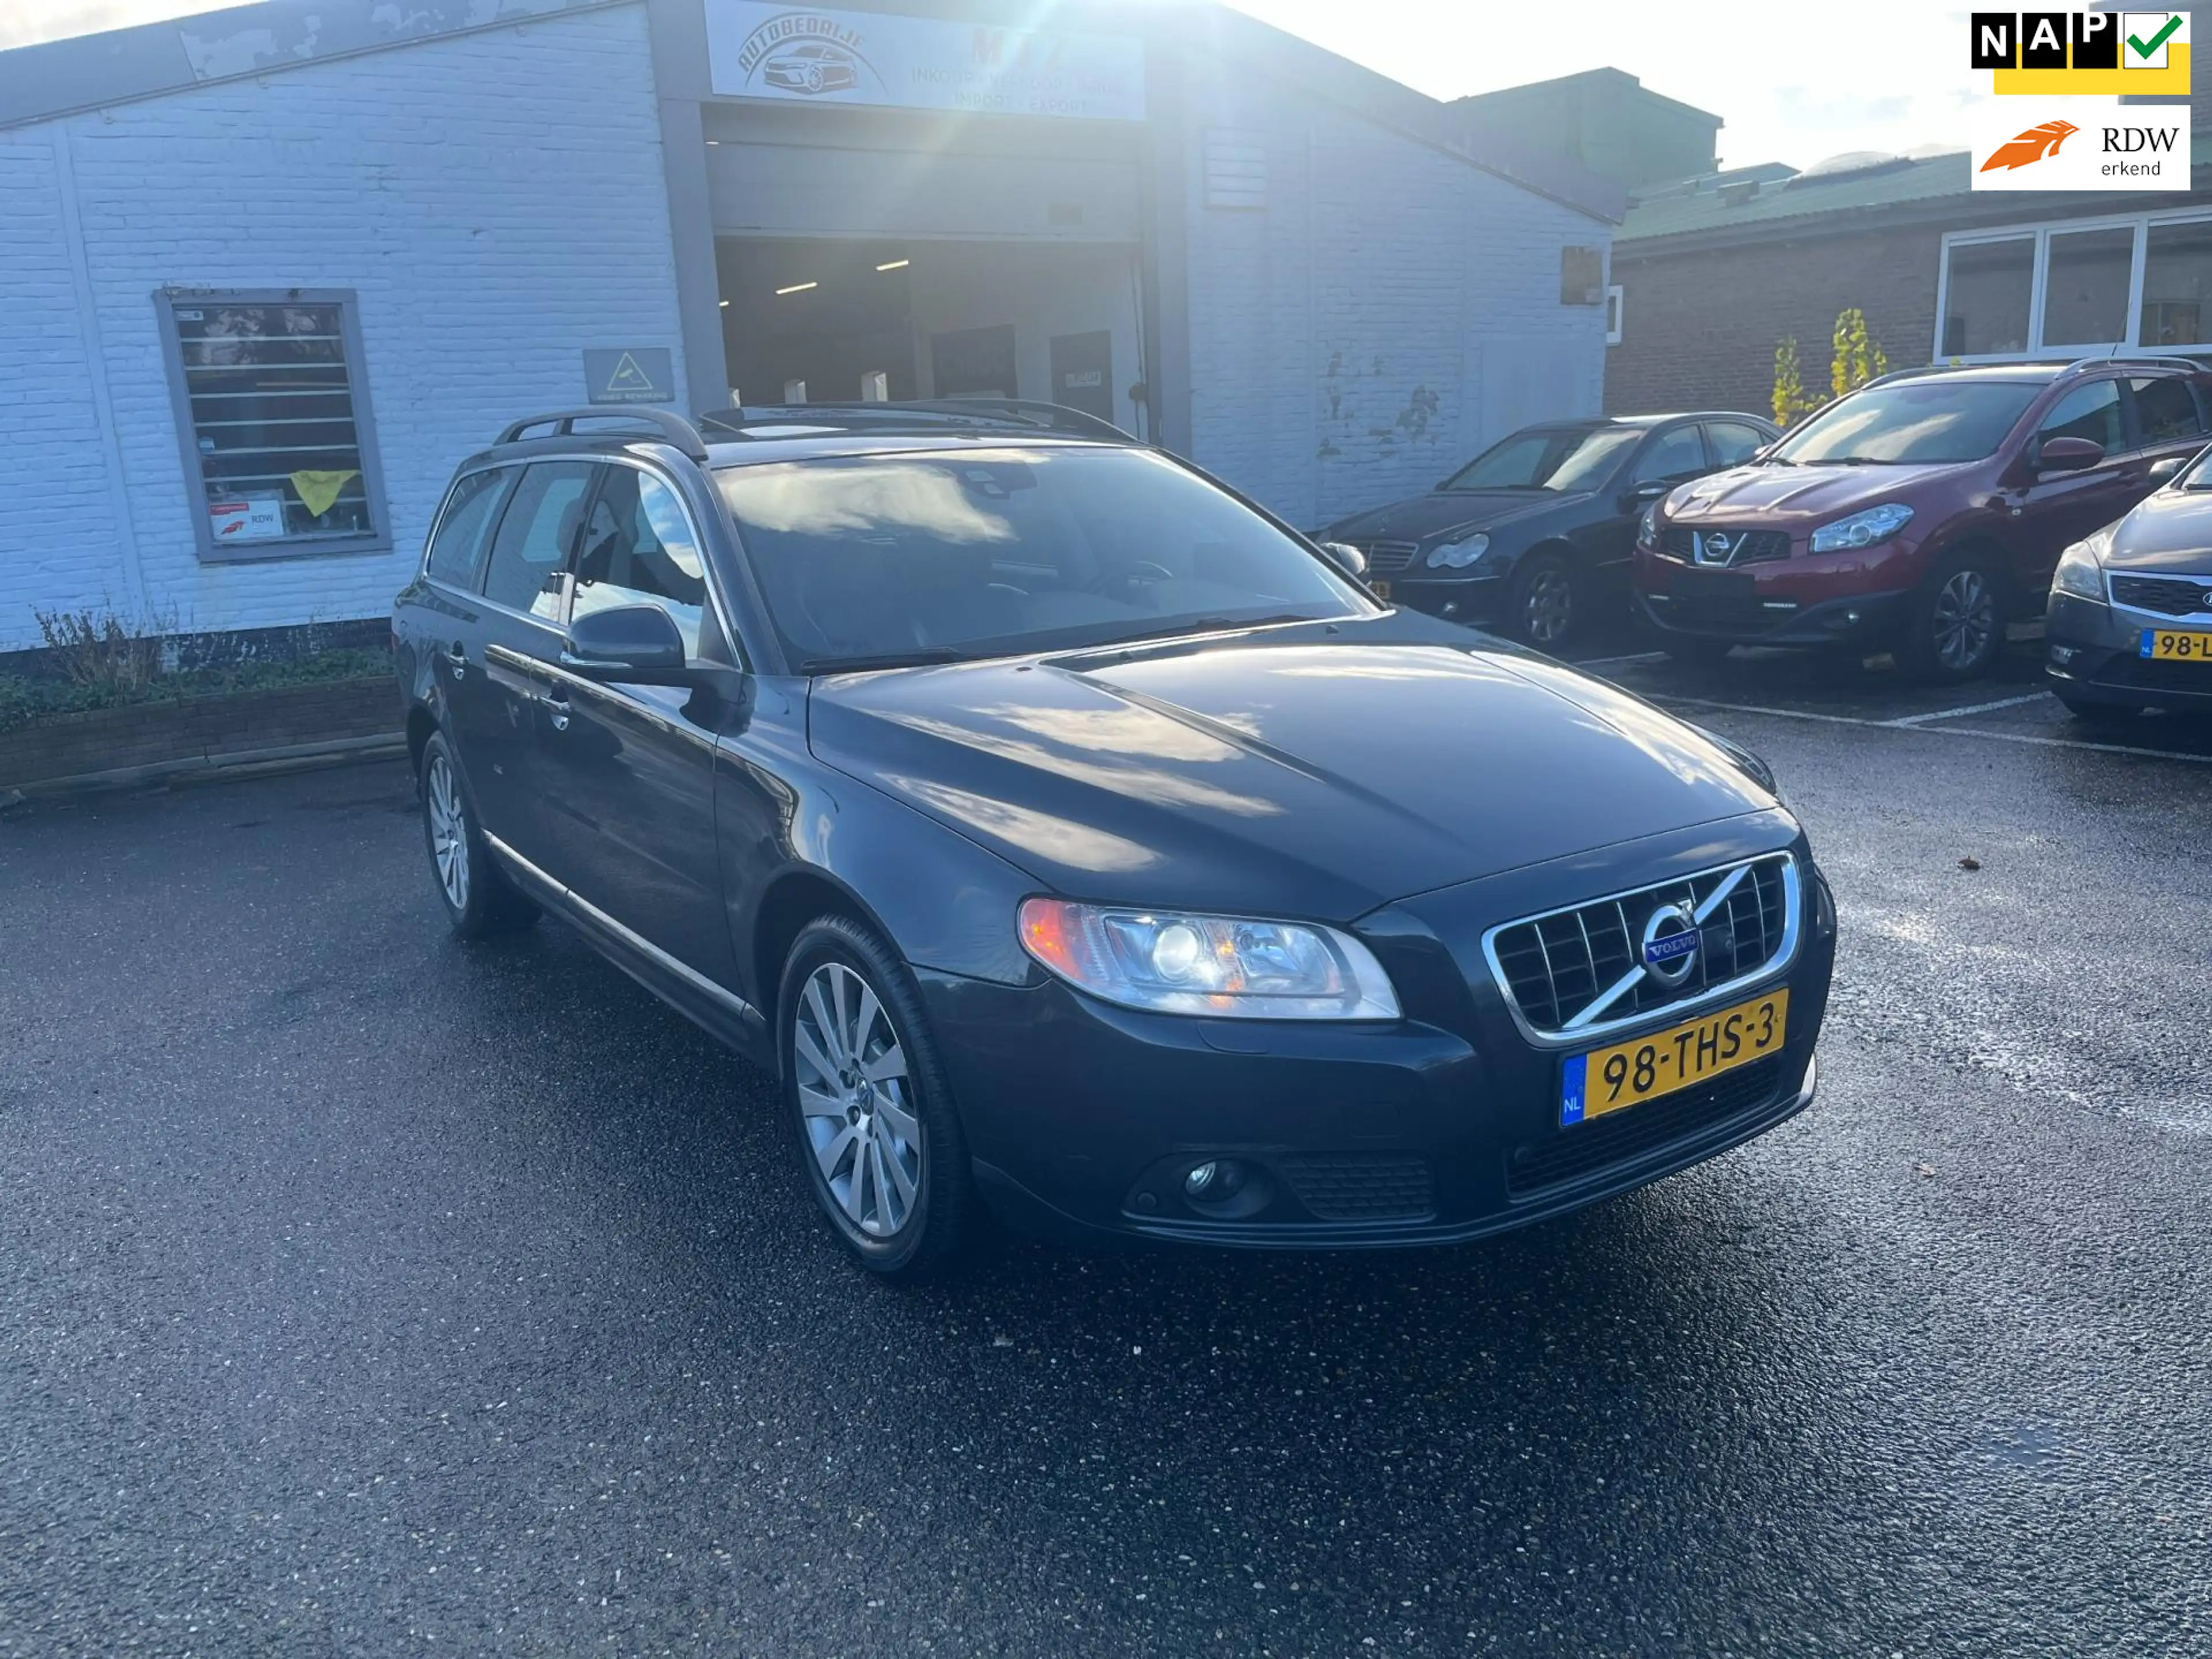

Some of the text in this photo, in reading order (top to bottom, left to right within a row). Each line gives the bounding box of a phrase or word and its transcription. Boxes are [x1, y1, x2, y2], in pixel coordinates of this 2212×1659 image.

[911, 67, 974, 85] INKOOP
[1648, 934, 1696, 956] VOLVO
[1603, 1002, 1774, 1103] 98-THS-3
[1564, 1099, 1581, 1113] NL
